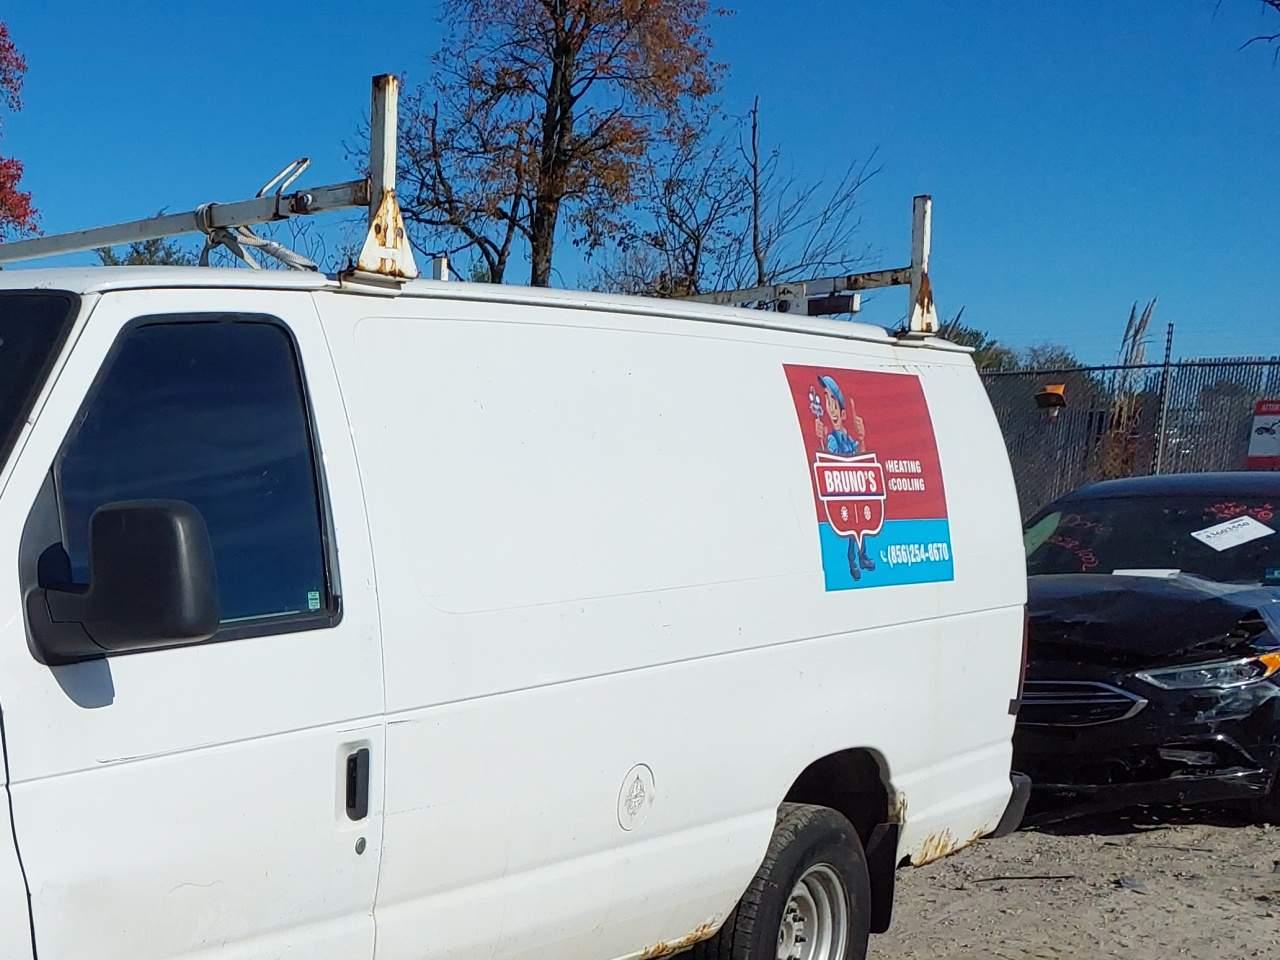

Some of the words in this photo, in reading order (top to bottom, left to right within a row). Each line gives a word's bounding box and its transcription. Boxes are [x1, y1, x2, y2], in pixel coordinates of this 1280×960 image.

[888, 460, 921, 473] HEATING
[824, 470, 877, 493] BRUNO'S
[891, 477, 925, 491] COOLING
[887, 543, 949, 568] (856)254-8670
